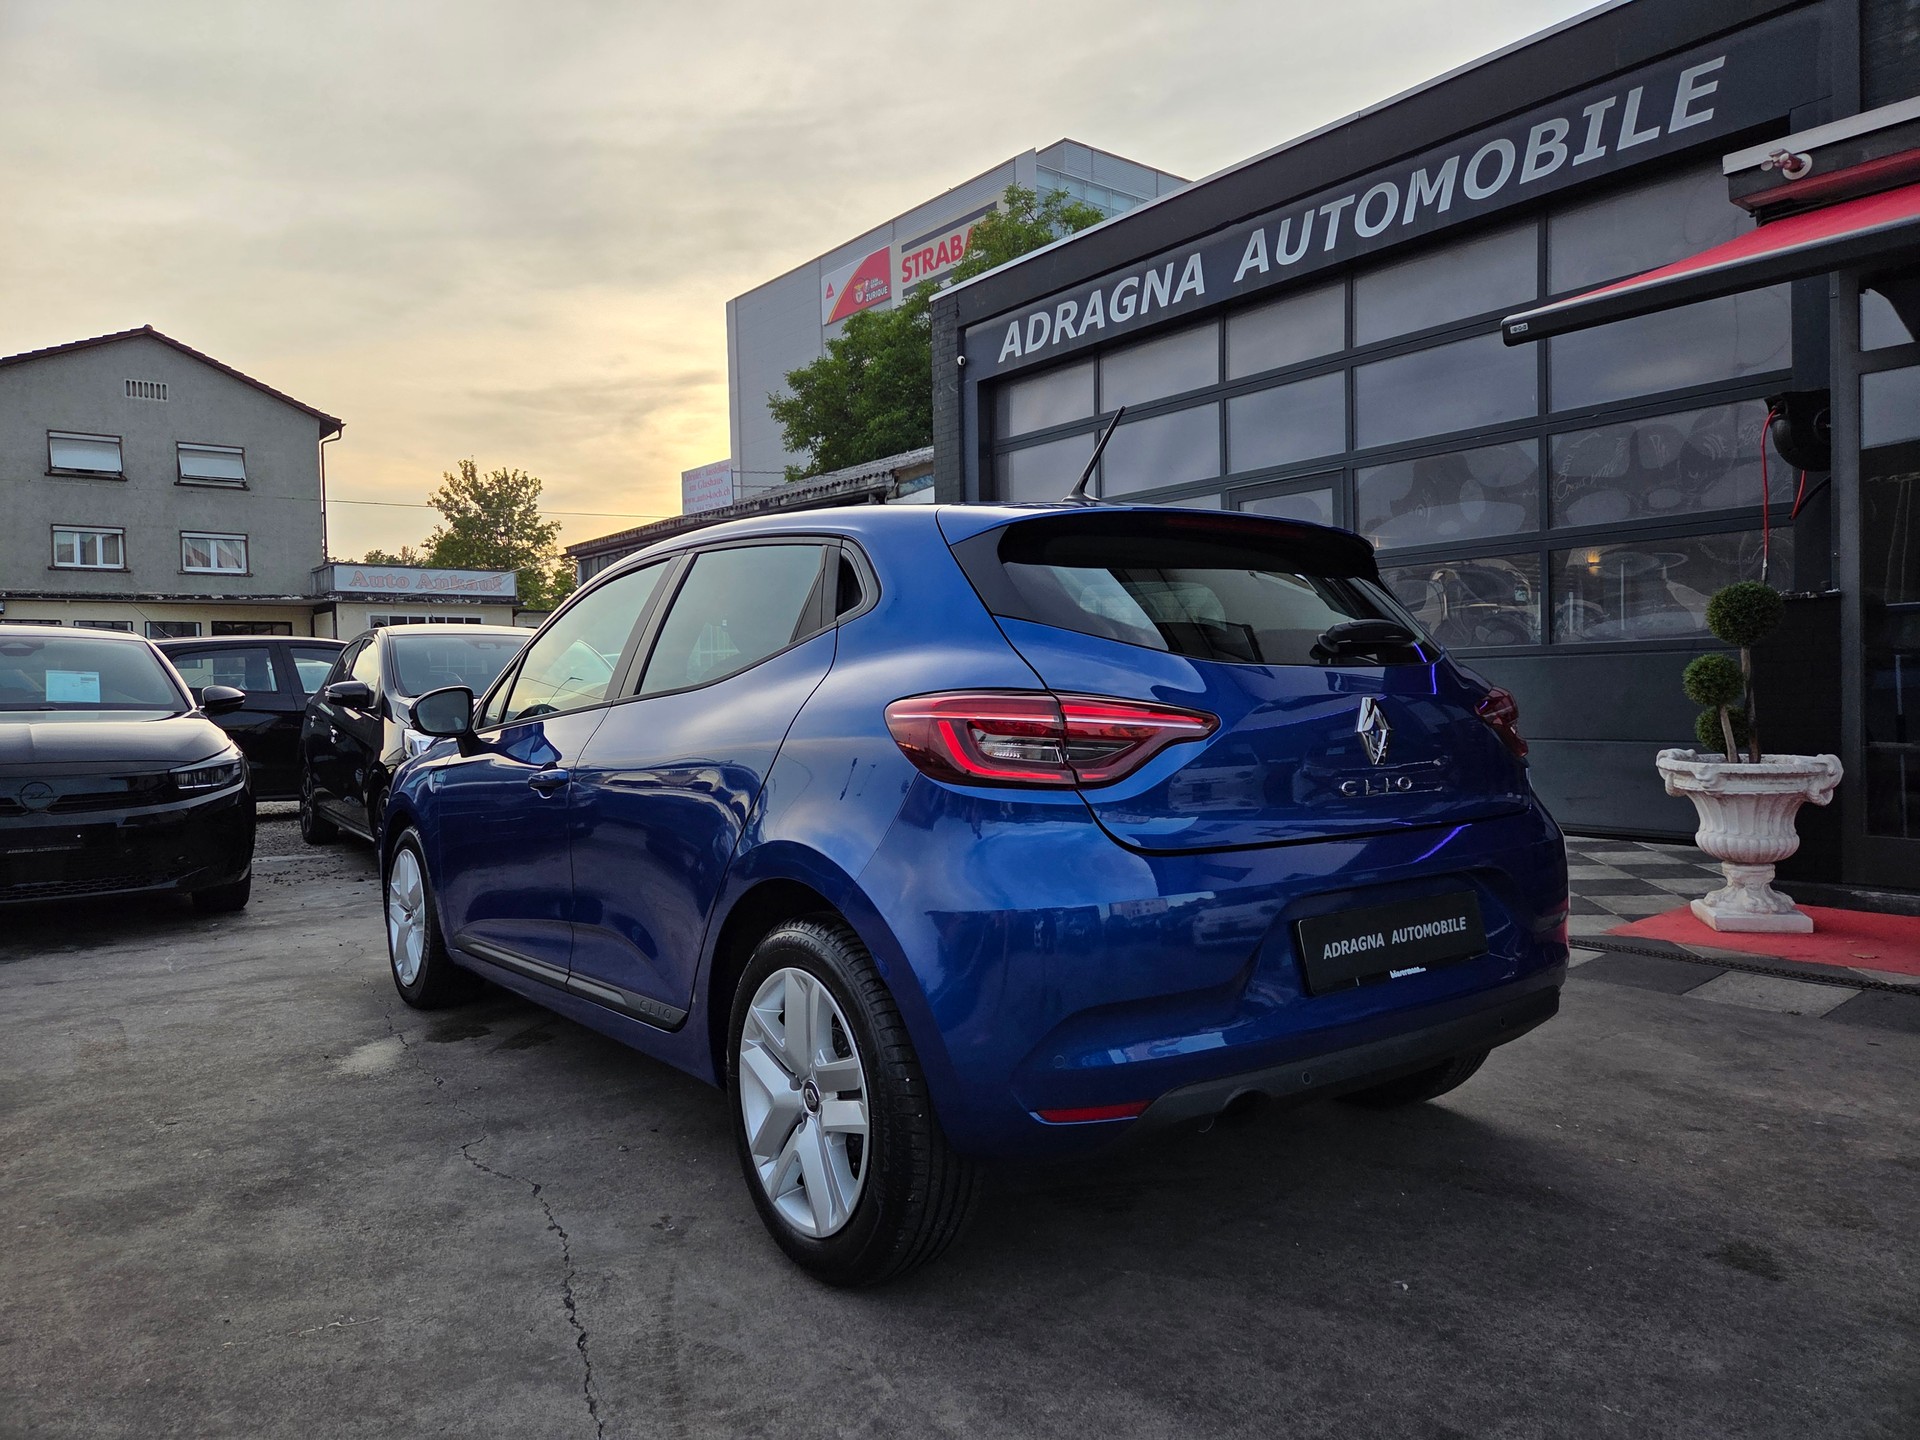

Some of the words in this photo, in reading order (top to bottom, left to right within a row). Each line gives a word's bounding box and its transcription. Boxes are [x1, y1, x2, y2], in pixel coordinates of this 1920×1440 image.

[998, 252, 1205, 363] ADRAGNA
[1233, 55, 1726, 283] AUTOMOBILE
[902, 222, 985, 283] STRAB
[866, 286, 888, 302] ZURIQUE
[349, 570, 410, 589] Auto
[416, 573, 503, 592] Ankauf
[1341, 777, 1413, 796] CLIO
[1323, 932, 1385, 960] ADRAGNA
[1391, 916, 1467, 945] AUTOMOBILE
[640, 1000, 672, 1019] CLIO
